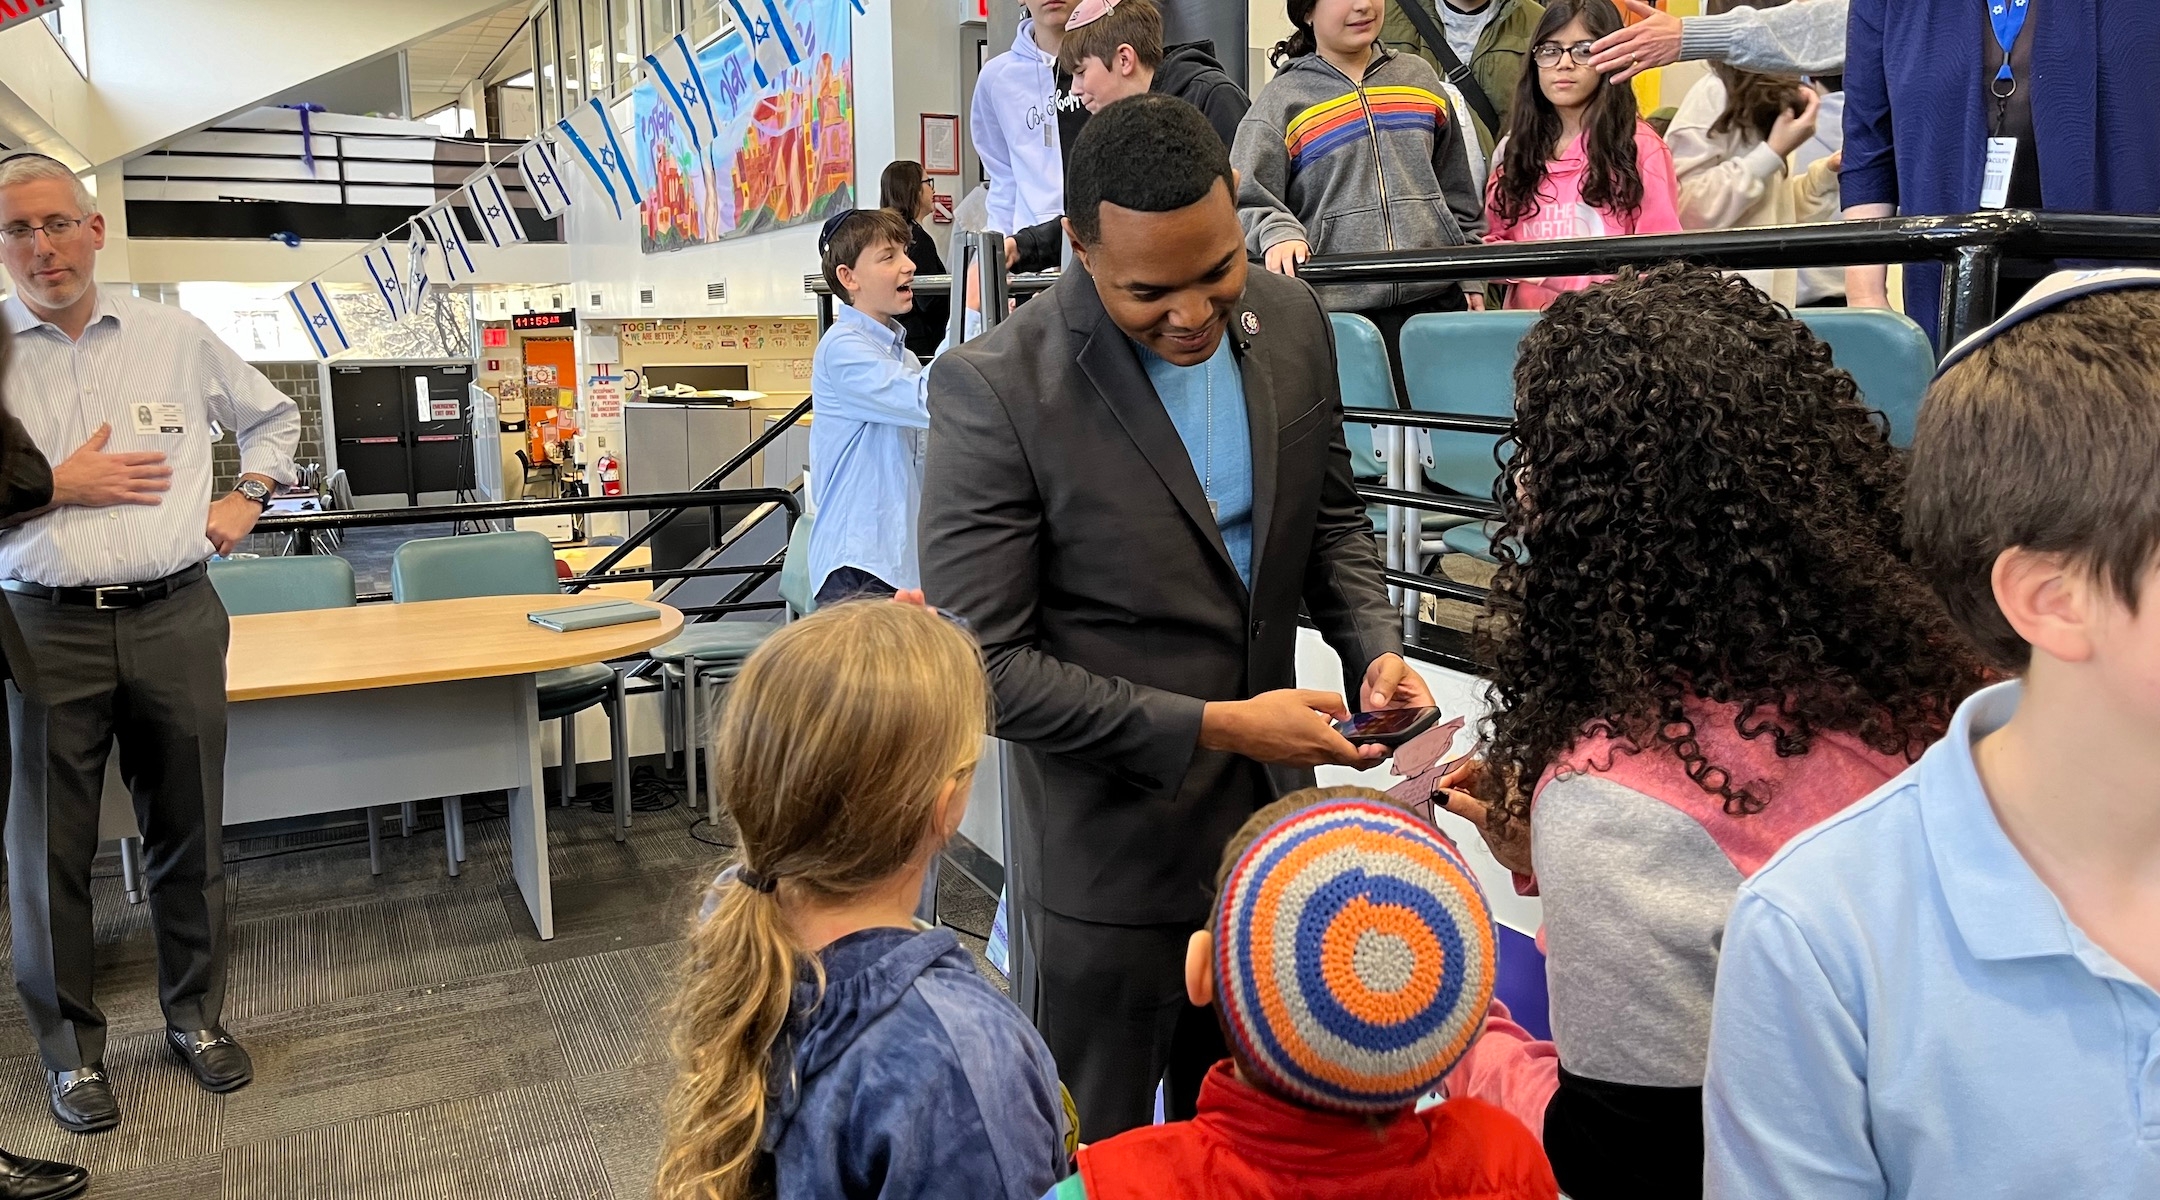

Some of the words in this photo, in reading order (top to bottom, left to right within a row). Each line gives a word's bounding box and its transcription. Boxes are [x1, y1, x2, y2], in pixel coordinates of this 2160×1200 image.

[1026, 105, 1045, 130] Be
[1543, 204, 1573, 220] THE
[1522, 220, 1573, 238] NORTH
[515, 316, 549, 327] 11:53
[631, 333, 640, 341] WE
[642, 332, 653, 340] ARE
[655, 332, 675, 340] BETTER
